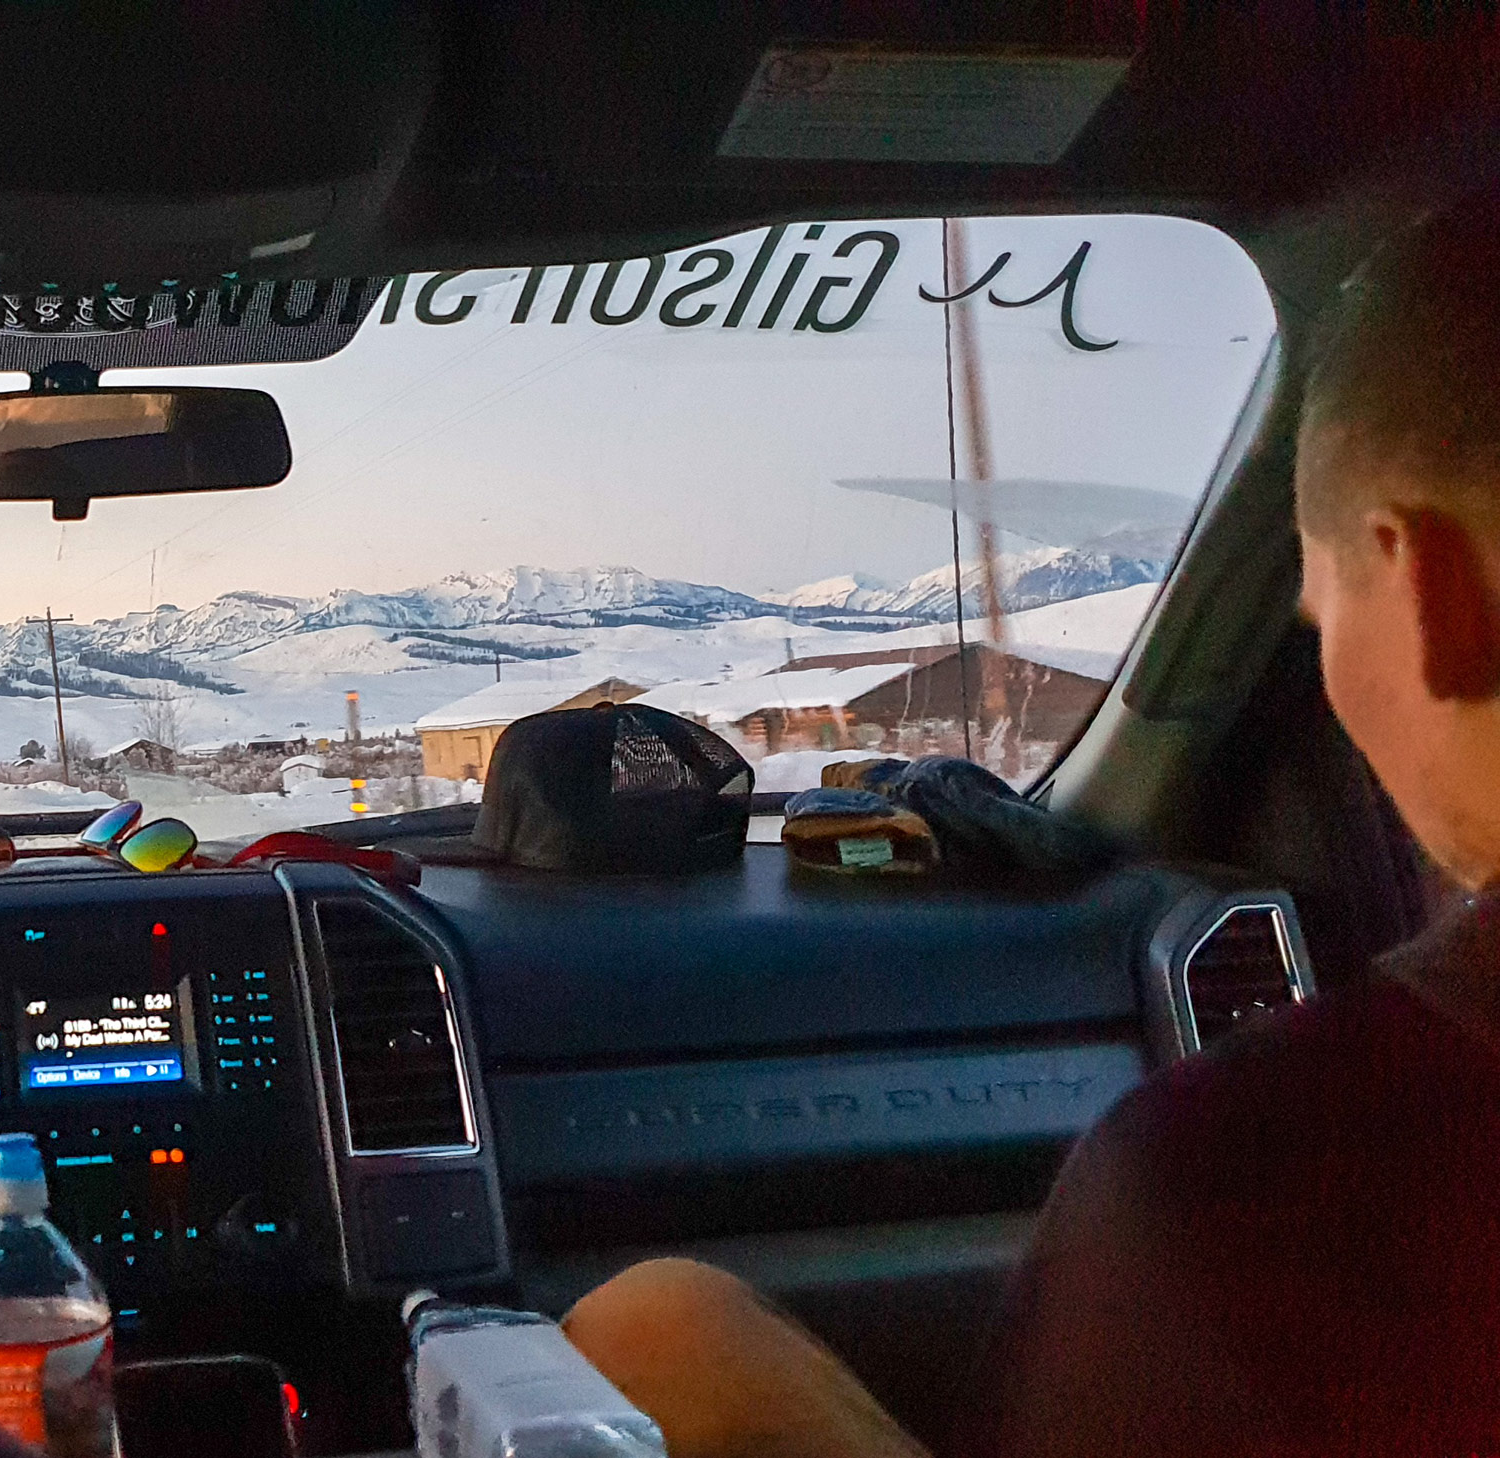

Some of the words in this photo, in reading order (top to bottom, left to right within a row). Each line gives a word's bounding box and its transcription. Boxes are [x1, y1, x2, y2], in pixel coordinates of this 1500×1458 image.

[144, 993, 173, 1010] 5:24
[82, 1032, 104, 1047] Dad
[134, 1031, 144, 1043] A
[36, 1071, 68, 1084] Options
[73, 1069, 101, 1081] Device
[114, 1067, 131, 1079] Info
[884, 1076, 1093, 1111] DUTY
